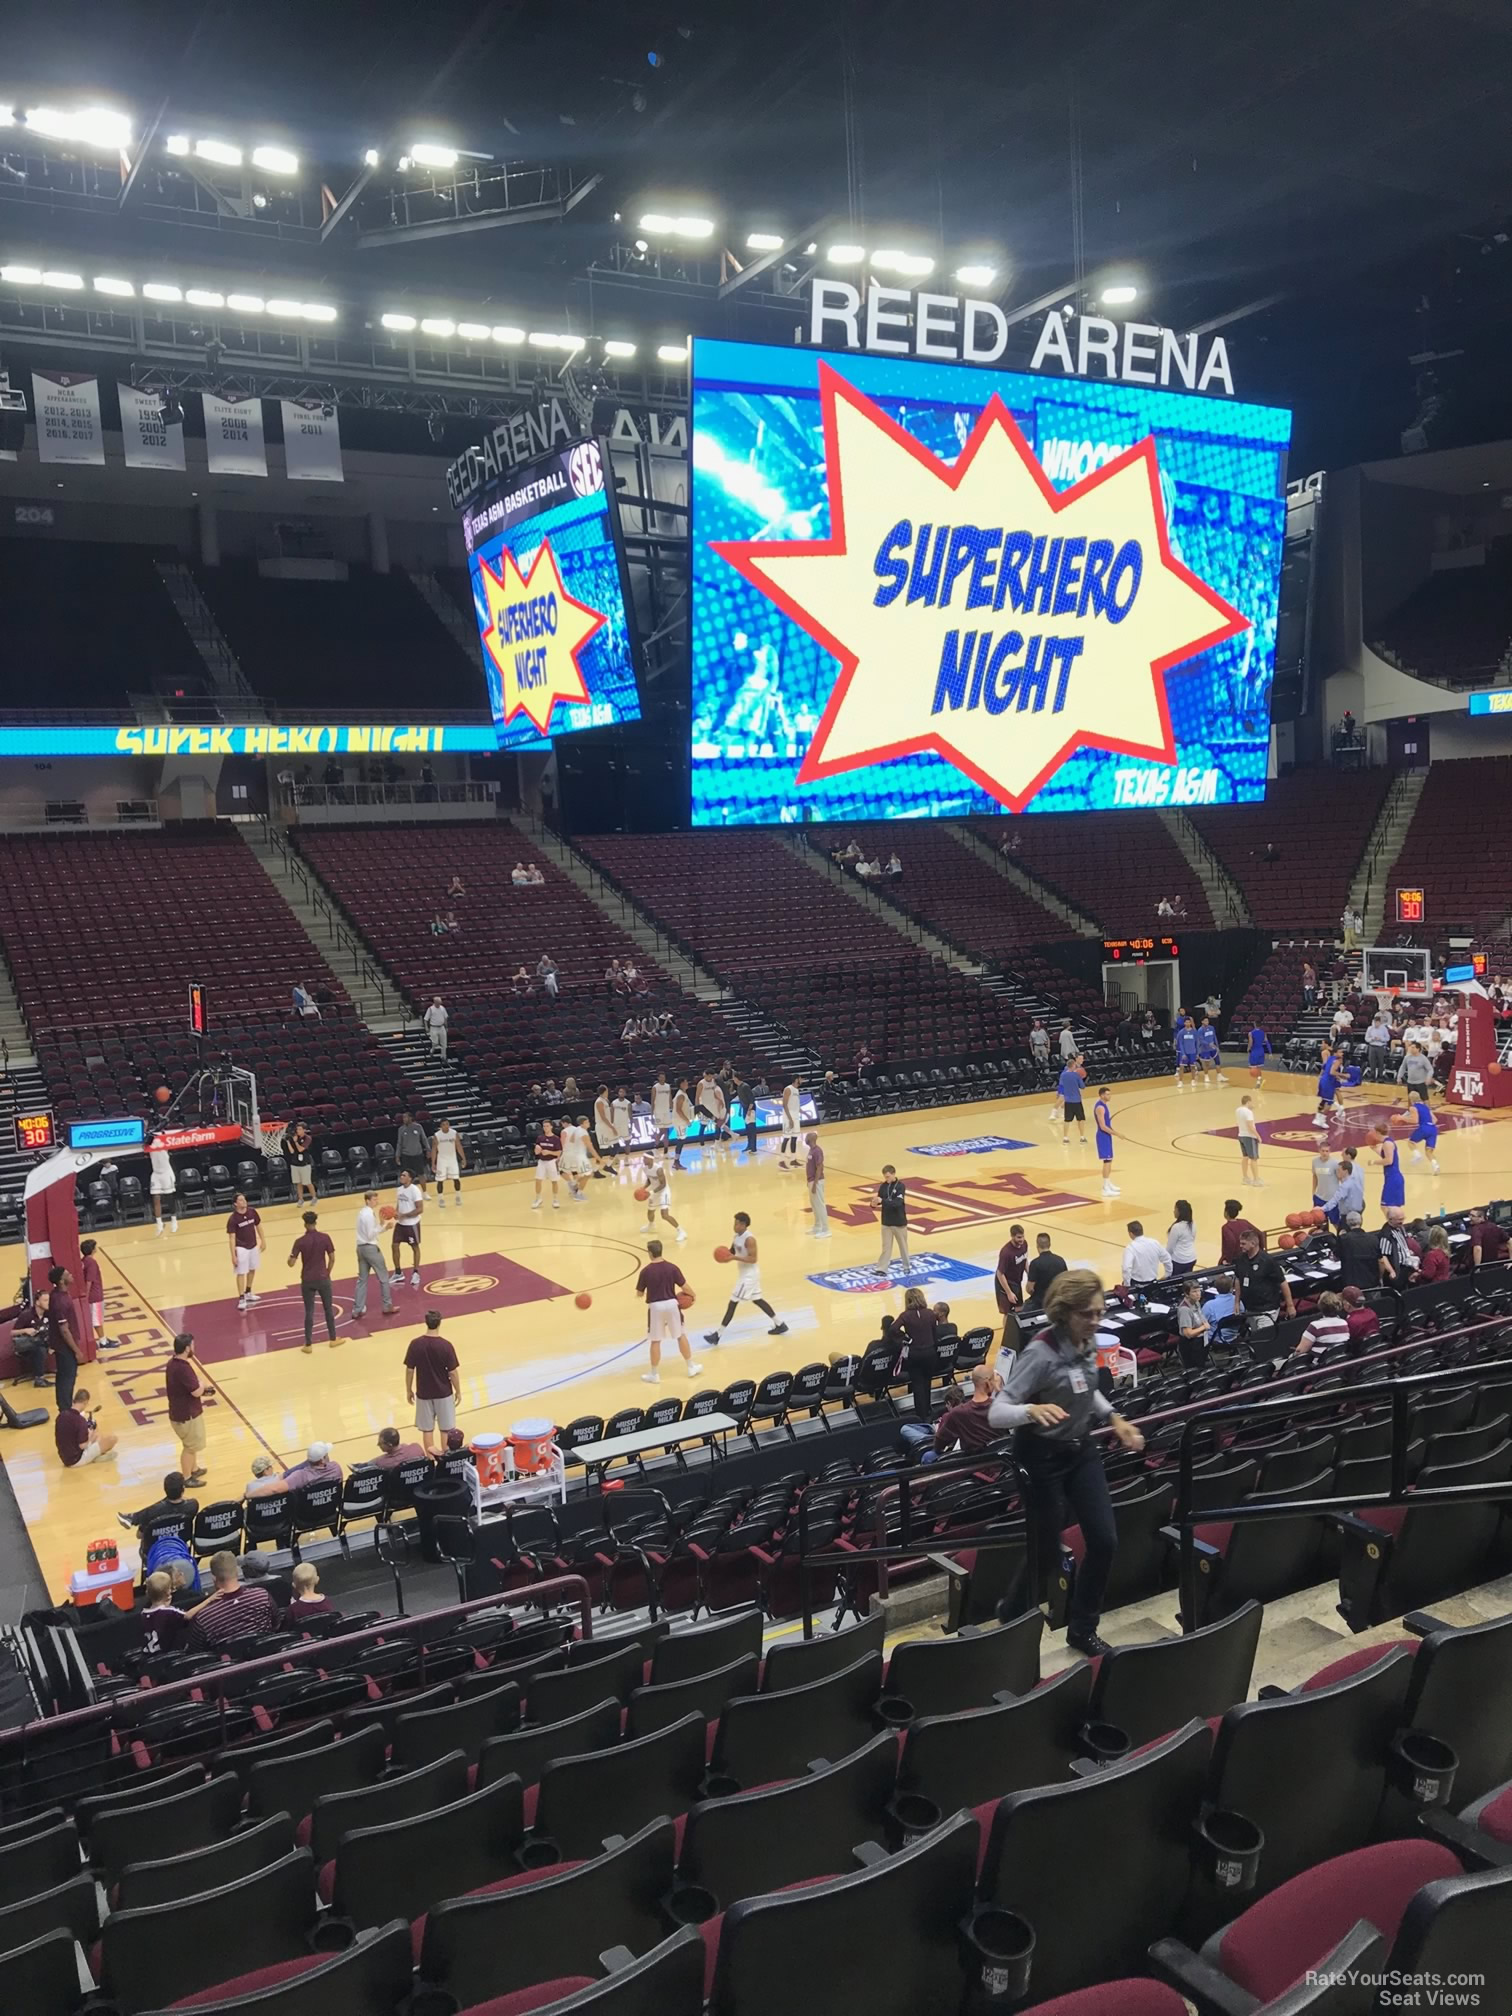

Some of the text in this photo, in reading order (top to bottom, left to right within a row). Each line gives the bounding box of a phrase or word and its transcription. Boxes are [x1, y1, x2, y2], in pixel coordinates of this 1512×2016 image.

[810, 279, 1236, 395] REED ARENA
[70, 408, 92, 418] 2013
[214, 406, 252, 416] ELITE EIGHT
[72, 419, 93, 429] 2015
[221, 417, 247, 430] 2008
[73, 430, 93, 441] 2017
[223, 429, 248, 441] 2014
[300, 424, 323, 436] 2011
[142, 435, 167, 447] 2012
[446, 448, 479, 507] REED
[483, 398, 572, 481] ARENA
[571, 443, 603, 497] SEC
[471, 512, 489, 536] TEXAS
[504, 471, 567, 514] BASKETBALL
[15, 507, 54, 524] 204
[872, 519, 1143, 625] SUPERHERO
[498, 591, 558, 650] SUPERHERO
[514, 645, 547, 693] NIGHT
[930, 629, 1085, 716] NIGHT
[1113, 767, 1219, 806] TEXAS A&M
[1400, 892, 1422, 902] 40:06
[1403, 902, 1420, 918] 30
[1129, 939, 1154, 949] 40:06
[1171, 945, 1178, 955] 0
[1113, 949, 1120, 959] 0
[18, 1116, 49, 1130] 40:06
[25, 1129, 45, 1145] 30
[79, 1127, 136, 1140] PROGRESSIVE
[164, 1132, 215, 1147] StateFarm
[937, 1342, 958, 1352] MUSCLE
[971, 1341, 986, 1350] MILK
[940, 1349, 953, 1358] MILK
[874, 1362, 889, 1371] MILK
[802, 1370, 825, 1382] MUSCLE
[766, 1379, 790, 1391] MUSCLE
[805, 1378, 821, 1388] MILK
[729, 1388, 752, 1400] MUSCLE
[770, 1387, 785, 1396] MILK
[694, 1397, 718, 1409] MUSCLE
[733, 1396, 748, 1406] MILK
[653, 1406, 679, 1418] MUSCLE
[697, 1405, 713, 1415] MILK
[615, 1416, 641, 1429] MUSCLE
[657, 1414, 674, 1424] MILK
[573, 1423, 600, 1436] MUSCLE
[620, 1424, 636, 1434] MILK
[577, 1432, 594, 1442] MILK
[537, 1443, 547, 1454] G
[487, 1454, 498, 1465] G
[400, 1465, 429, 1479] MUSCLE
[450, 1465, 465, 1475] MIL
[353, 1474, 383, 1488] MUSCLE
[404, 1474, 424, 1485] MILK
[306, 1486, 337, 1500] MUSCLE
[358, 1483, 378, 1495] MILK
[255, 1497, 288, 1511] MUSCLE
[312, 1495, 332, 1506] MILK
[204, 1510, 237, 1524] MUSCLE
[261, 1505, 282, 1517] MILK
[151, 1522, 185, 1537] MUSCLE
[210, 1519, 232, 1531] MILK
[98, 1562, 108, 1571] G
